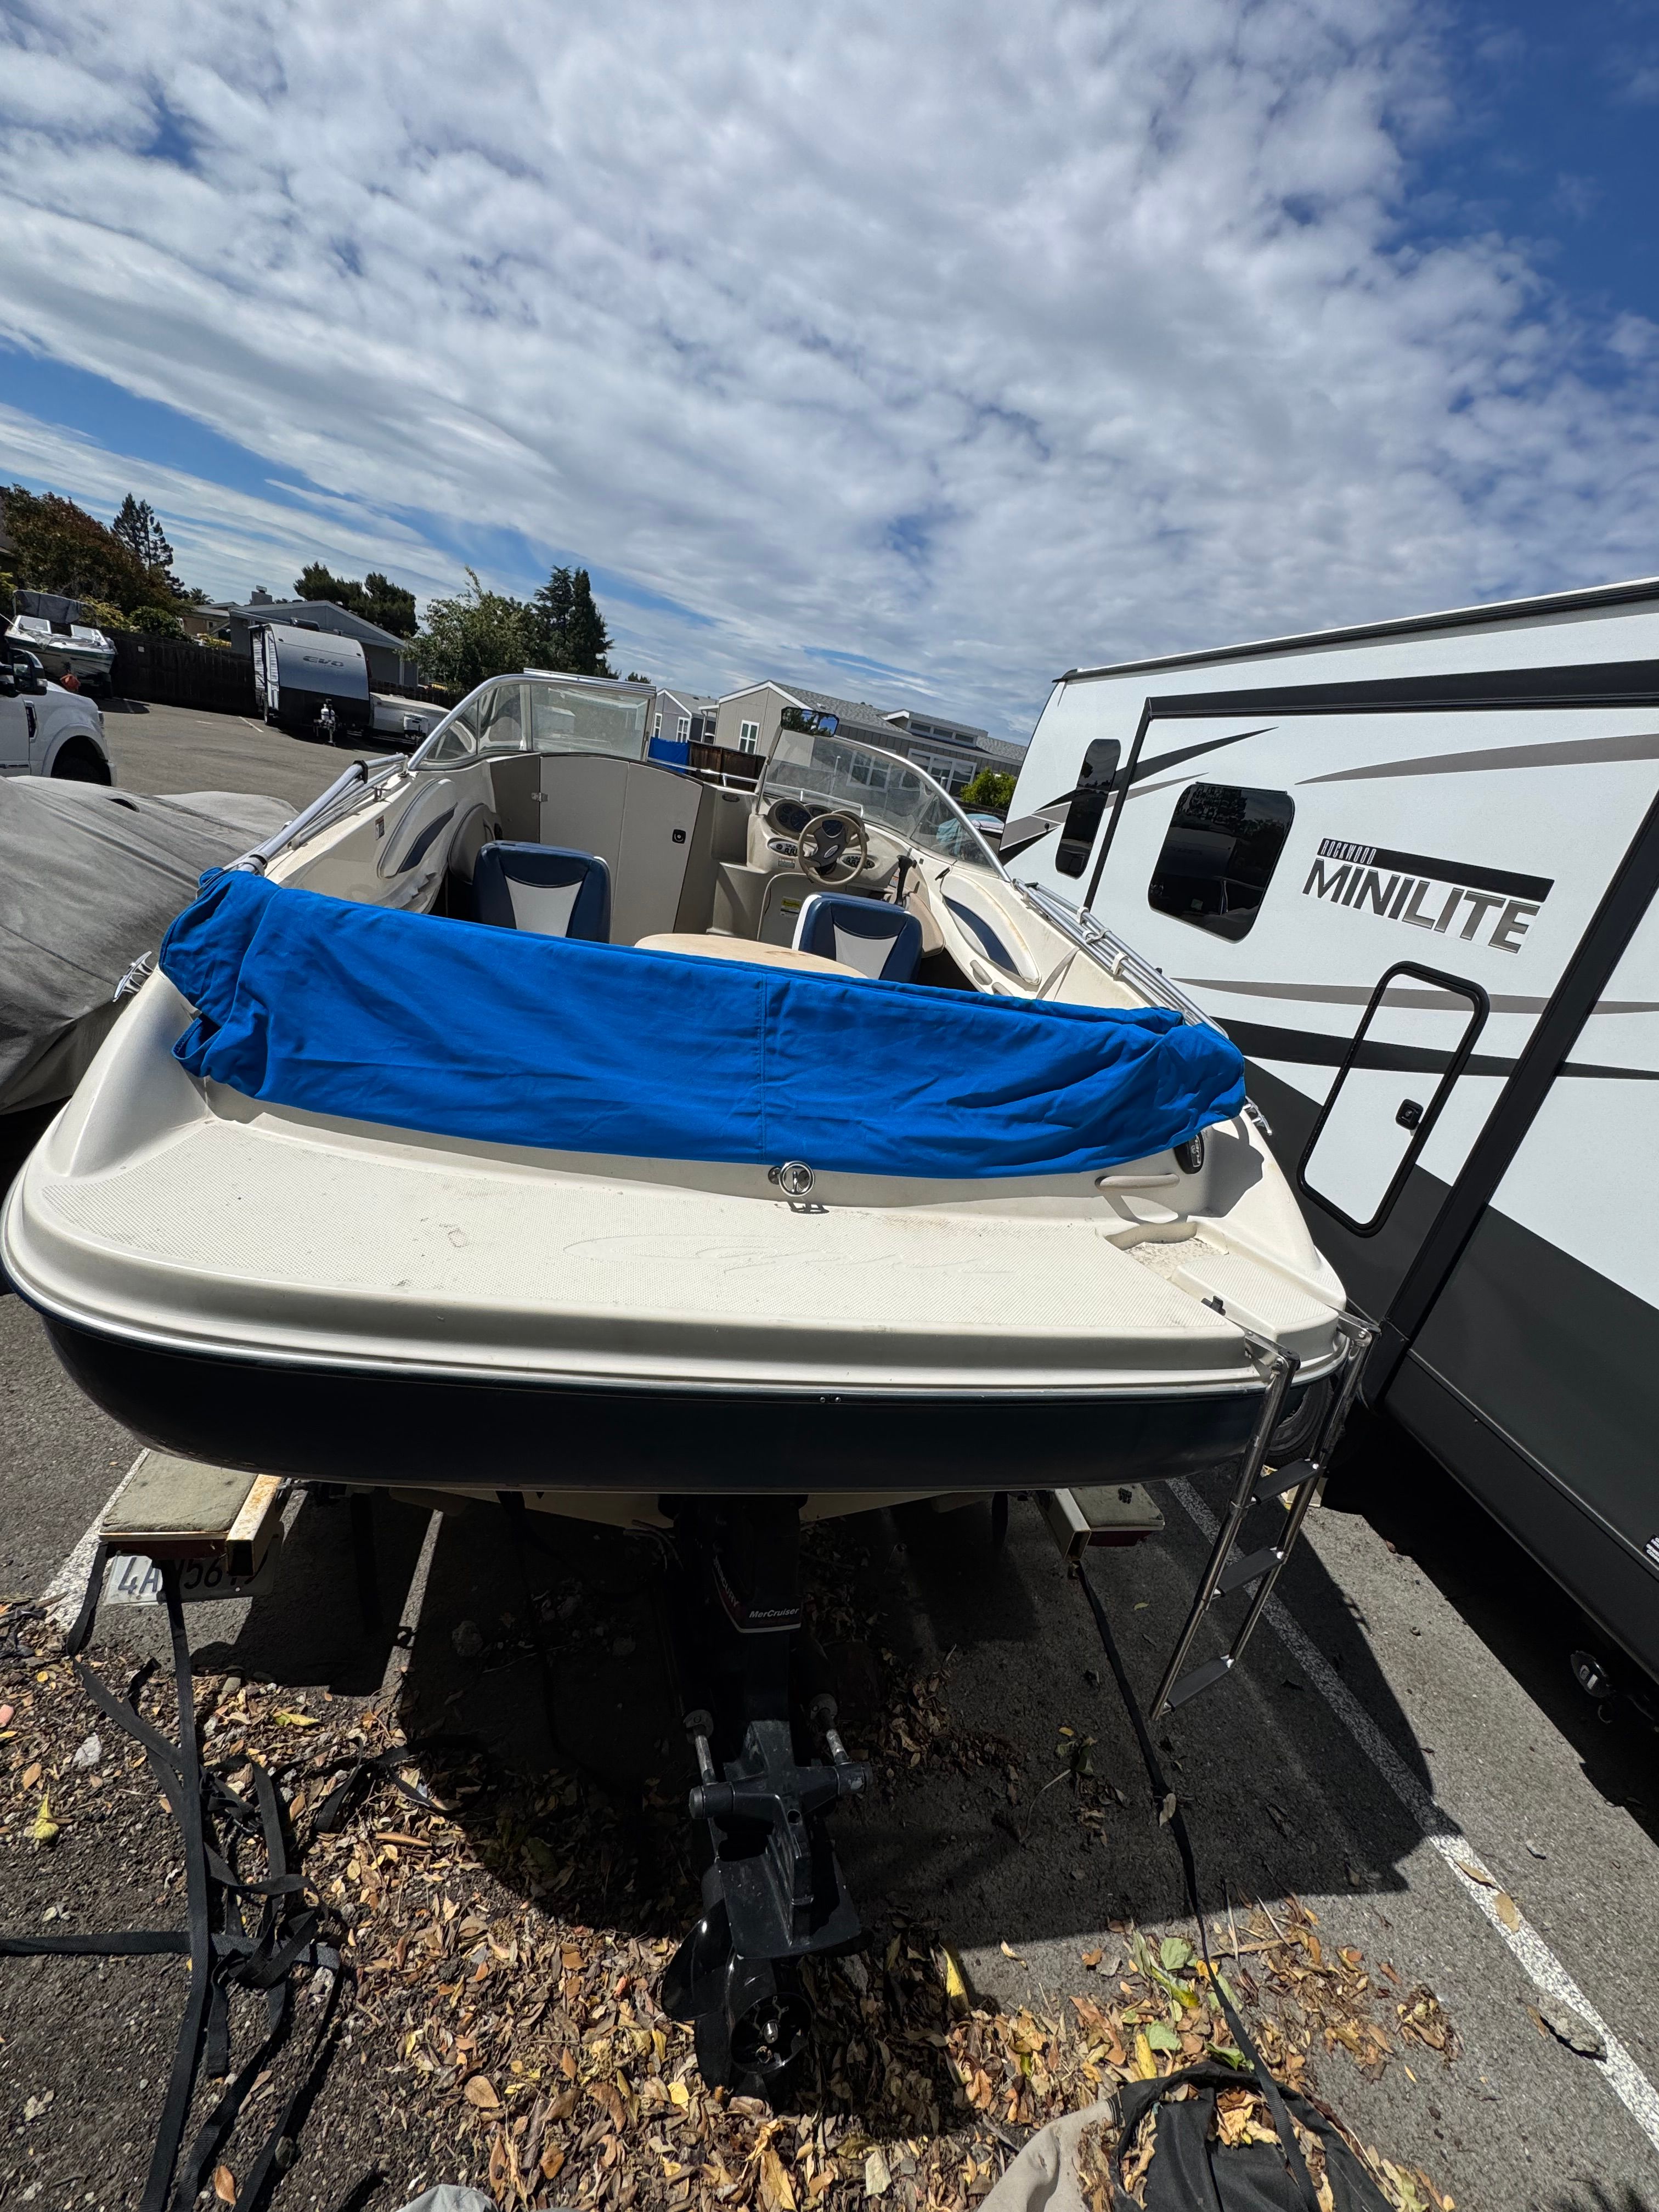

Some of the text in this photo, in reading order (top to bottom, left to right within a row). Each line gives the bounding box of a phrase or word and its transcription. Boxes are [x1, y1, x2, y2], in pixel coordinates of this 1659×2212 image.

[303, 656, 344, 667] EVO
[1321, 839, 1376, 865] ROCKWOOD
[1302, 858, 1541, 953] MINILITE
[749, 1607, 799, 1618] MerCruiser
